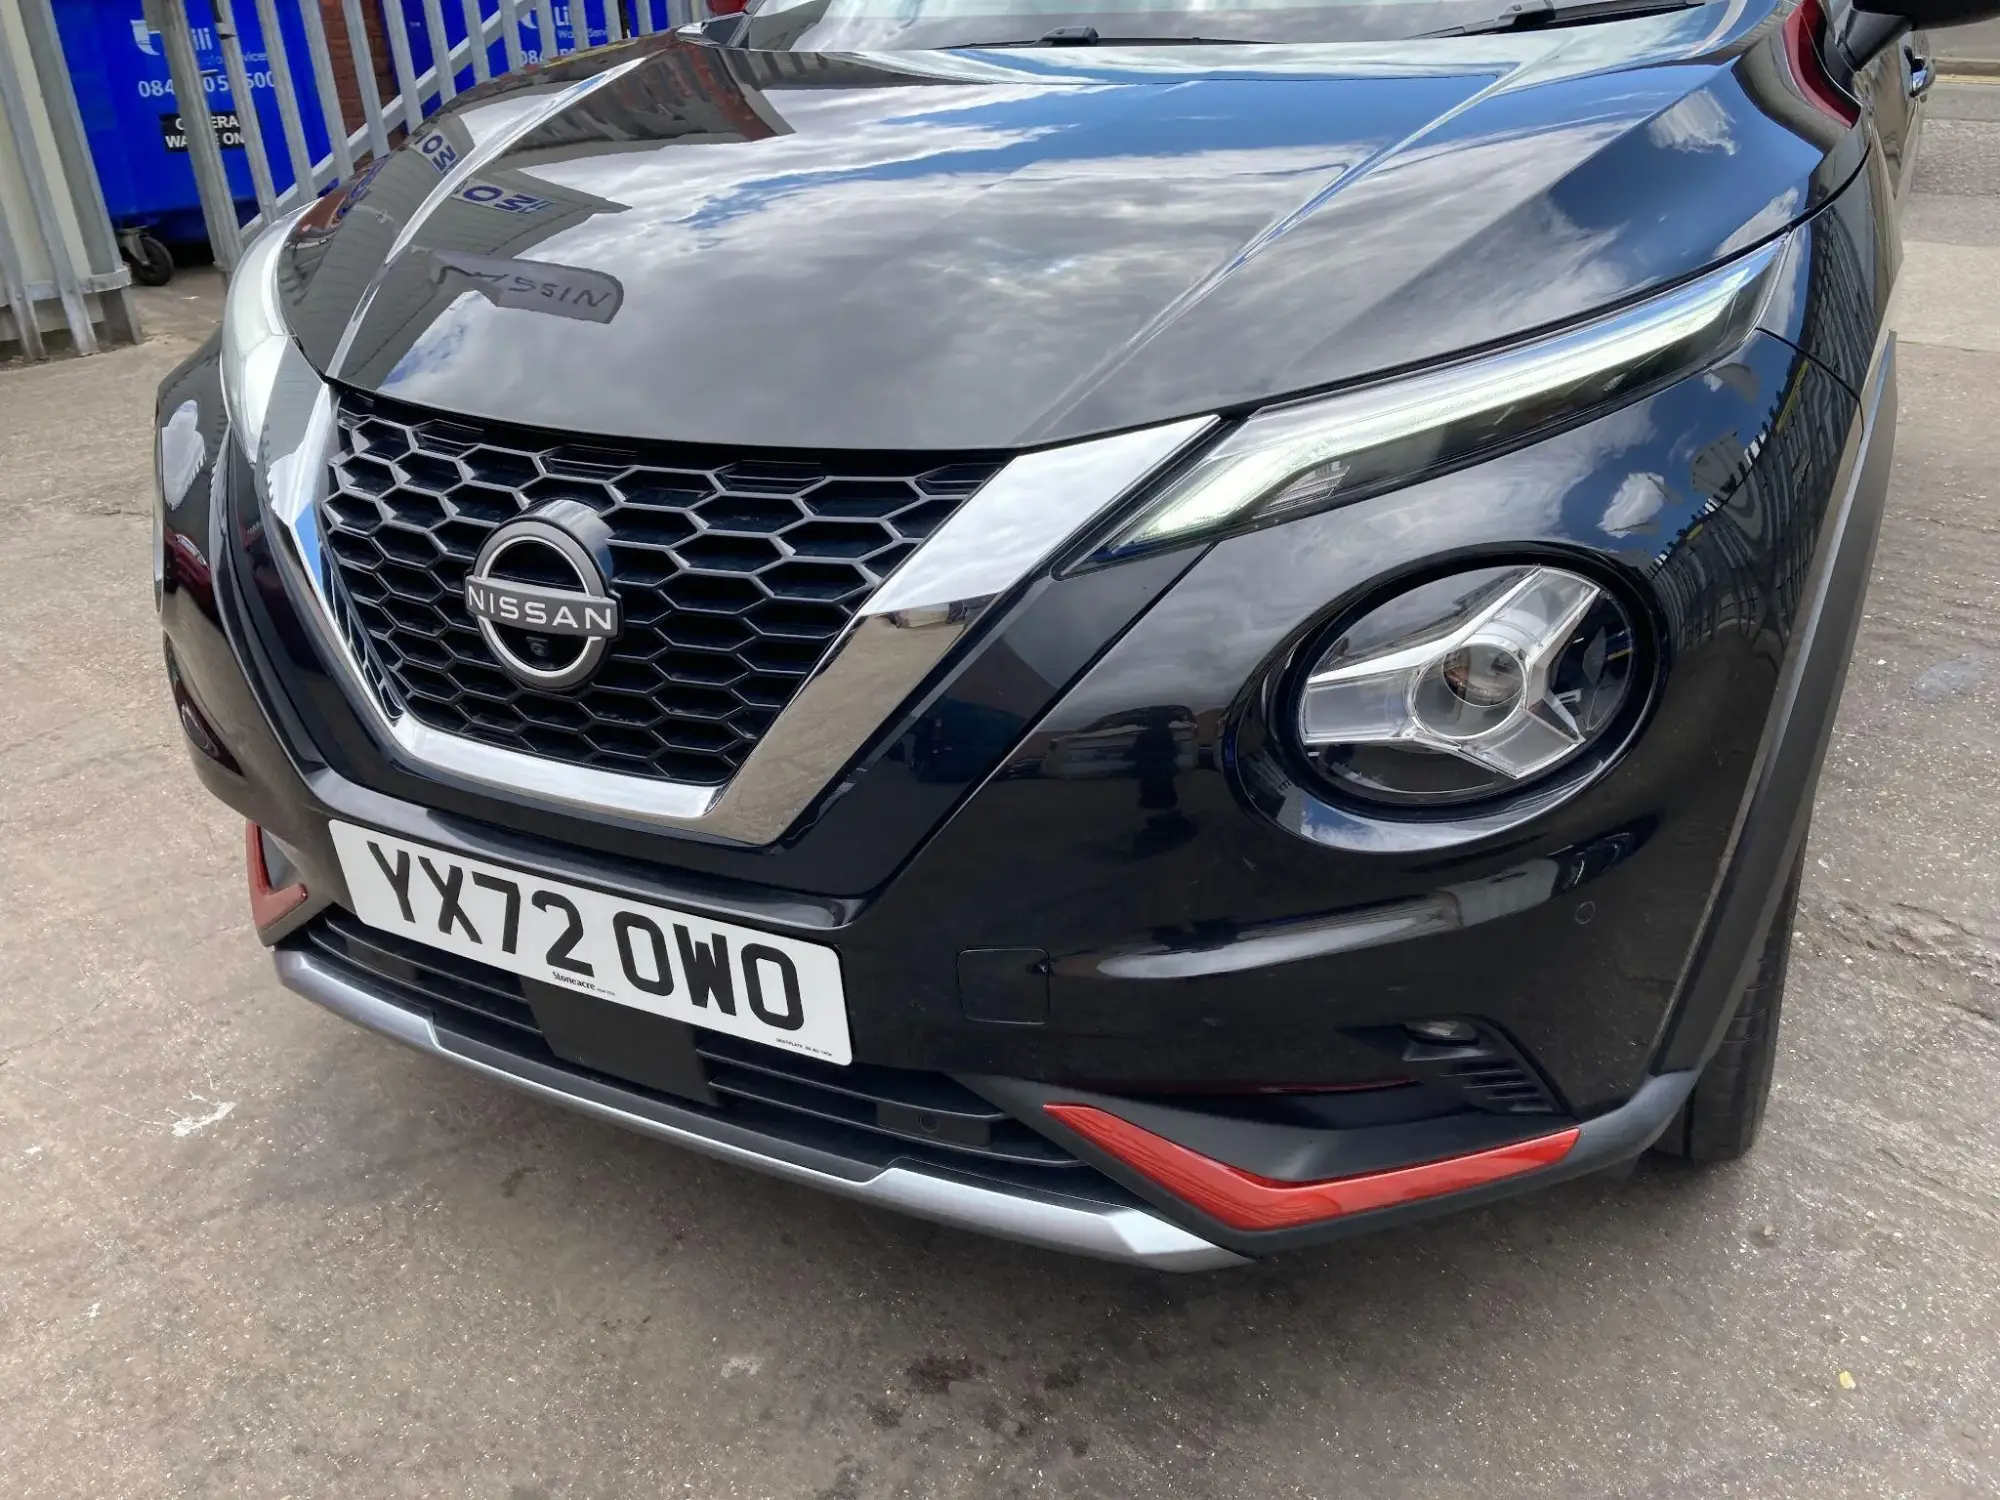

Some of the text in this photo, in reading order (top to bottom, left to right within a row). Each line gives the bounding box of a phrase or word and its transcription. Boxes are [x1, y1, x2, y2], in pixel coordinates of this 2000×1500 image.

[468, 585, 612, 630] NISSAN
[366, 841, 804, 1031] YX72 OWO
[552, 971, 596, 990] Stoneacre
